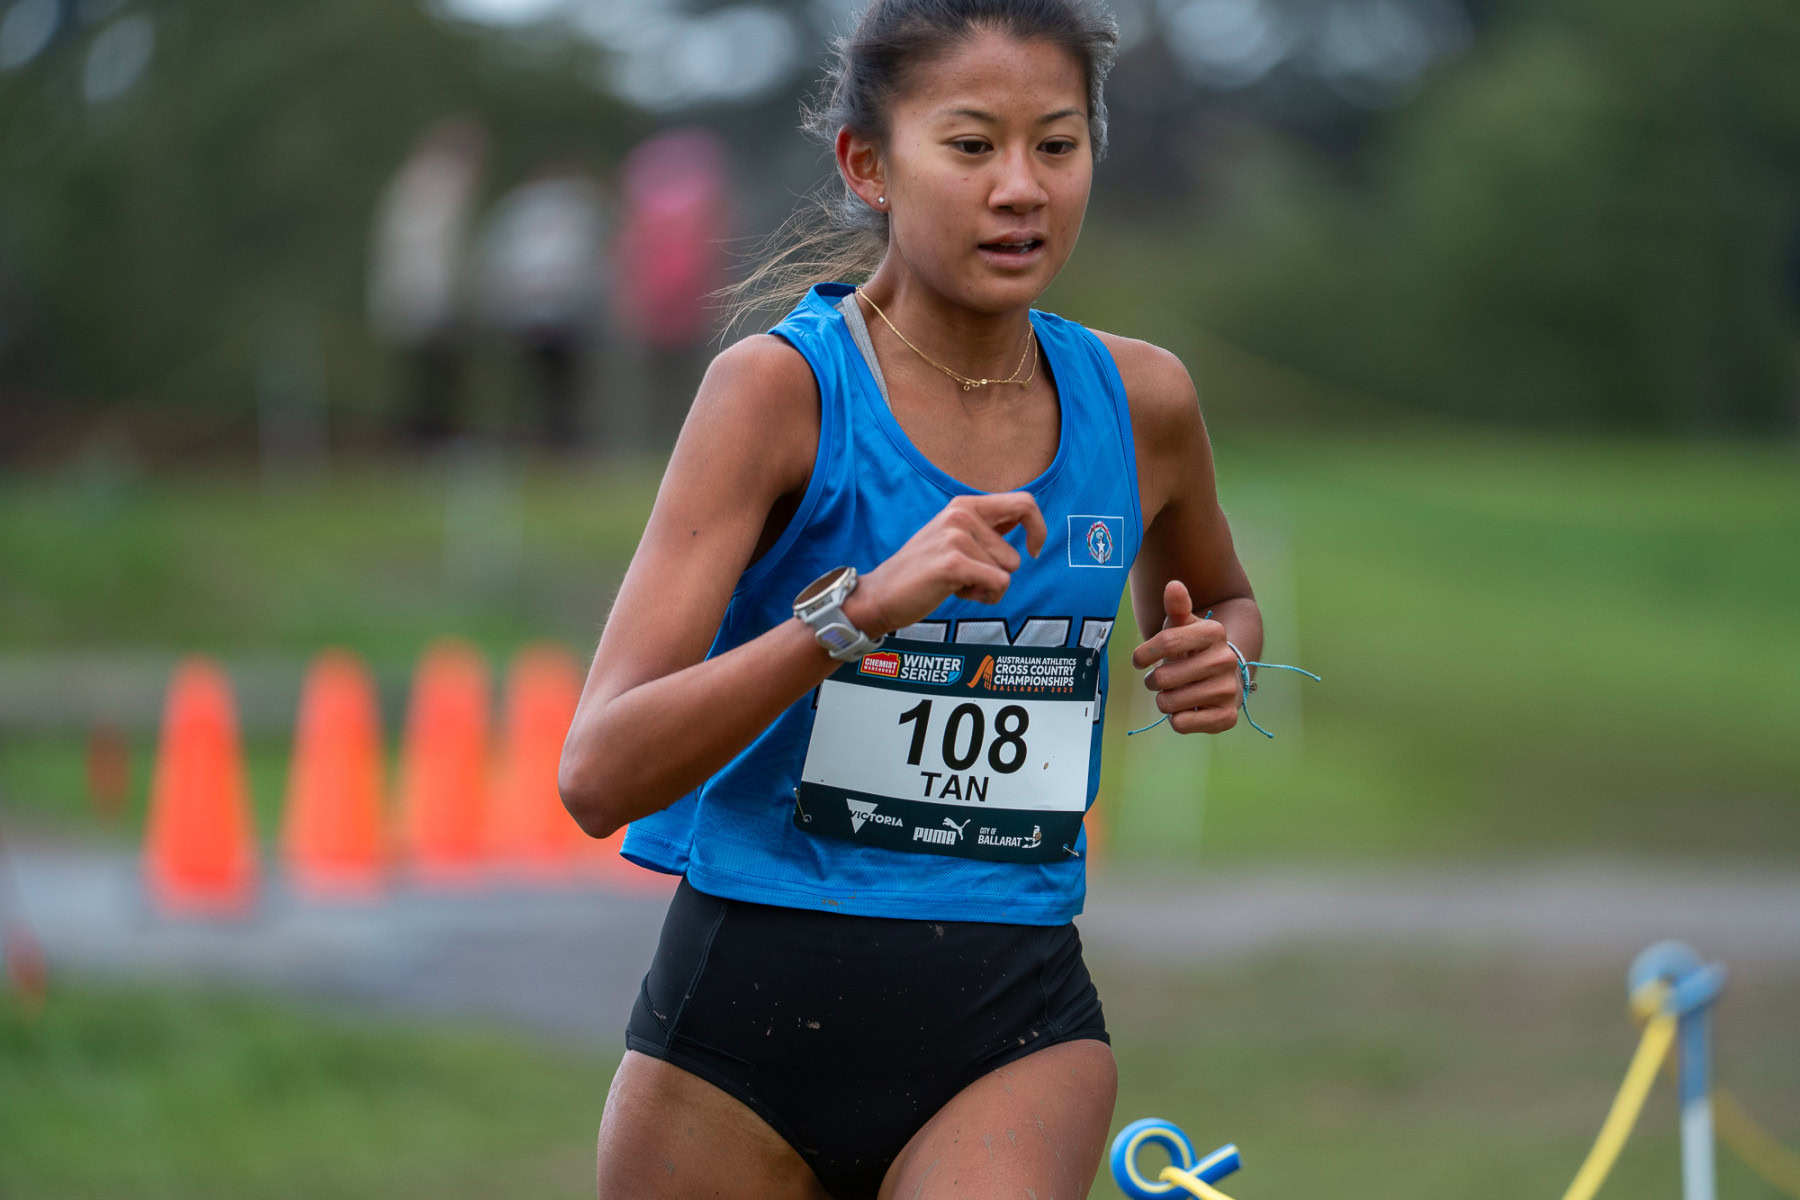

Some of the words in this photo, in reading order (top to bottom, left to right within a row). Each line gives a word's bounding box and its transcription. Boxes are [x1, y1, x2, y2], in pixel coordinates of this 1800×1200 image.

[864, 657, 898, 670] CHEMIST
[903, 654, 961, 671] WINTER
[996, 656, 1042, 665] AUSTRALIAN
[1042, 658, 1077, 666] ATHLETICS
[900, 667, 949, 683] SERIES
[995, 664, 1028, 675] CROSS
[1029, 665, 1076, 676] COUNTRY
[993, 675, 1075, 687] CHAMPIONSHIPS
[992, 685, 1045, 693] BALLARAT
[898, 699, 1029, 774] 108
[920, 771, 989, 802] TAN
[849, 810, 904, 828] VICTORIA
[912, 826, 957, 846] PUMA
[979, 826, 990, 835] CITY
[990, 827, 997, 835] OF
[977, 834, 1022, 847] BALLARAT
